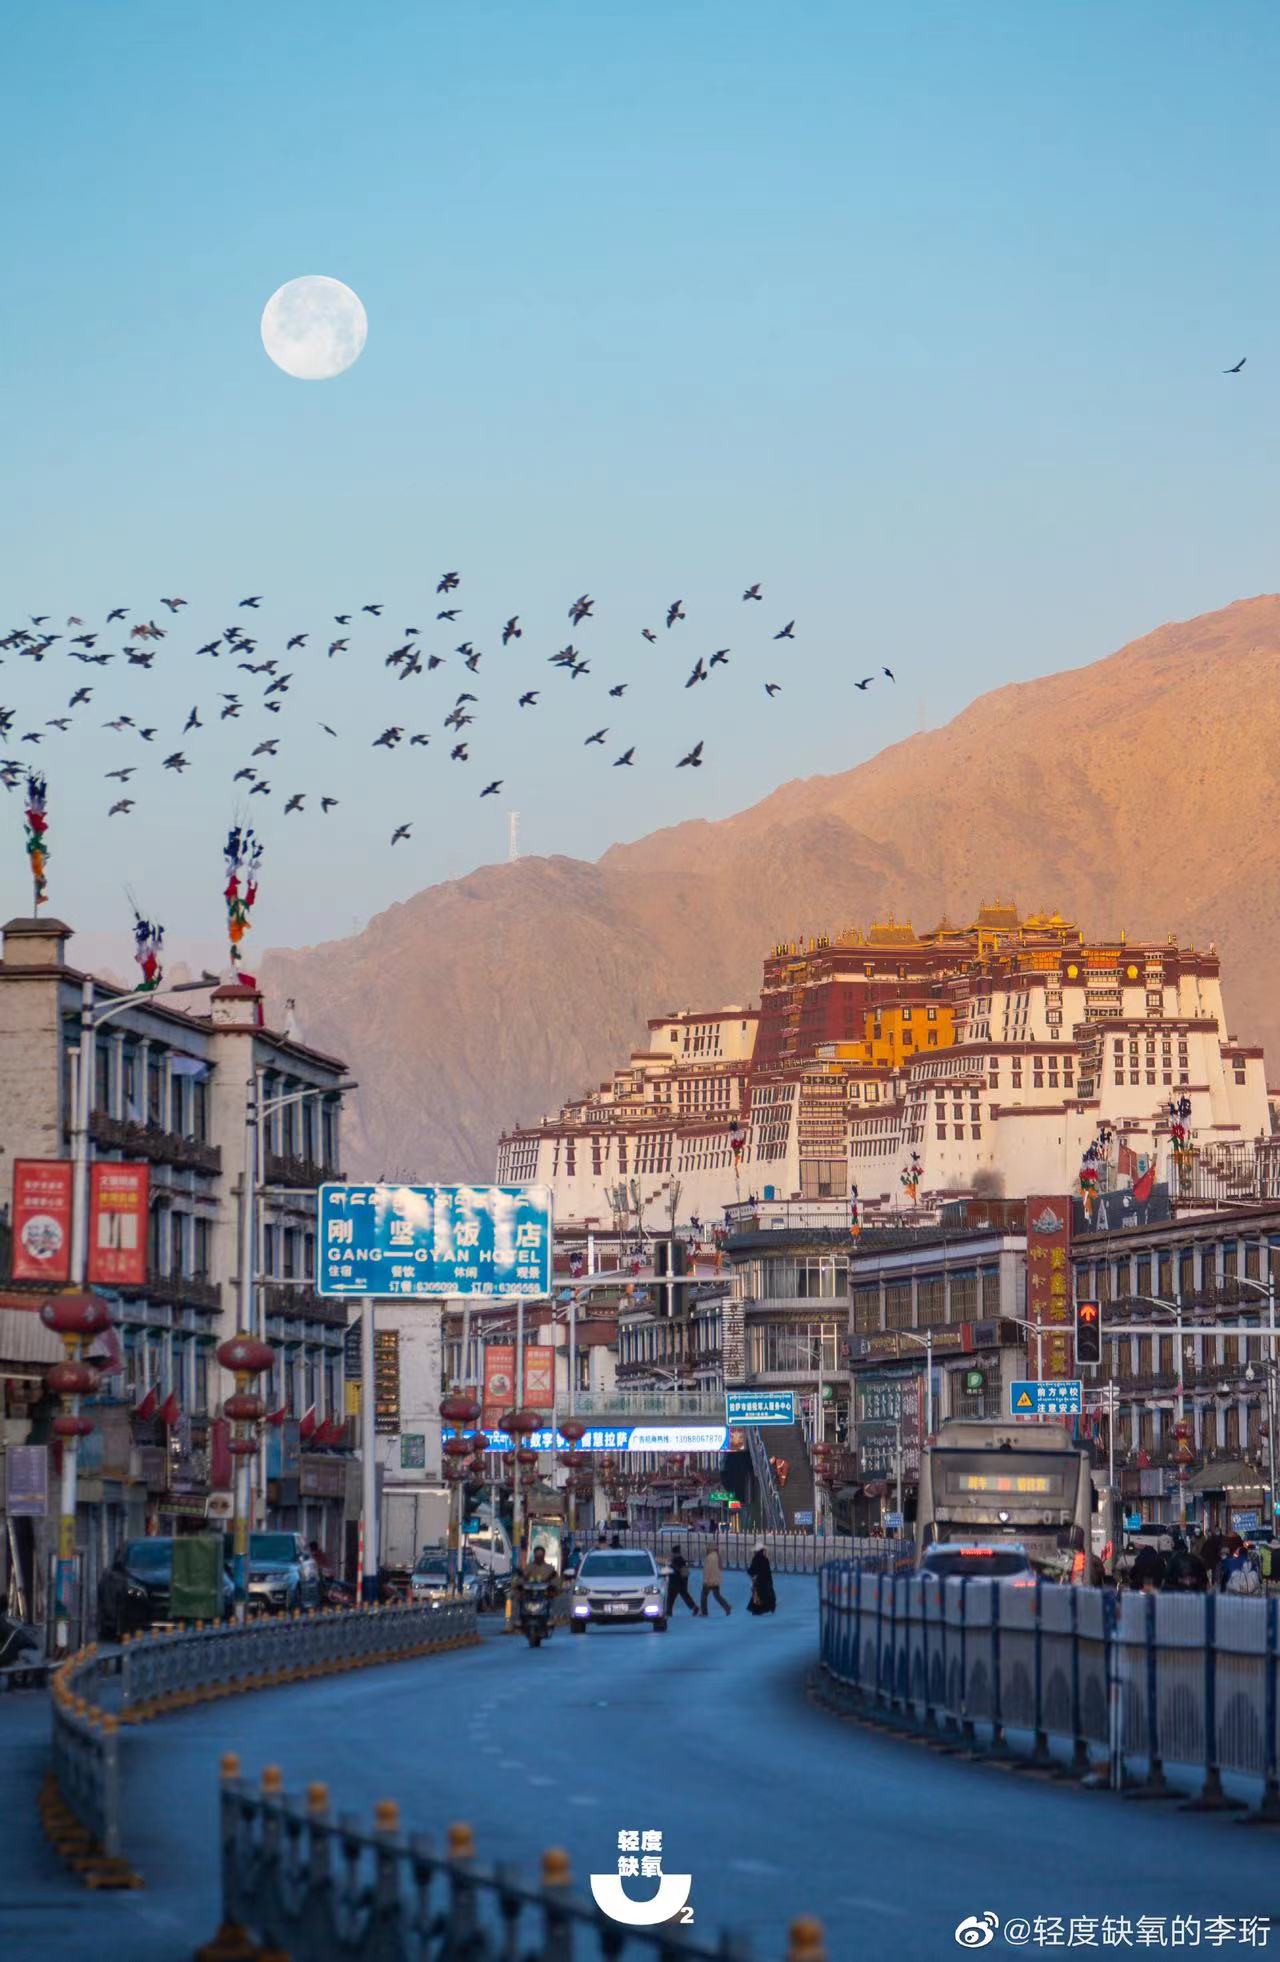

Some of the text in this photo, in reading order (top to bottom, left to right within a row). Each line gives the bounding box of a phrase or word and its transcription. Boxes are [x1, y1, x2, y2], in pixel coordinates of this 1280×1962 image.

[1037, 1387, 1079, 1397] 前方学校
[1037, 1403, 1079, 1413] 注意安全
